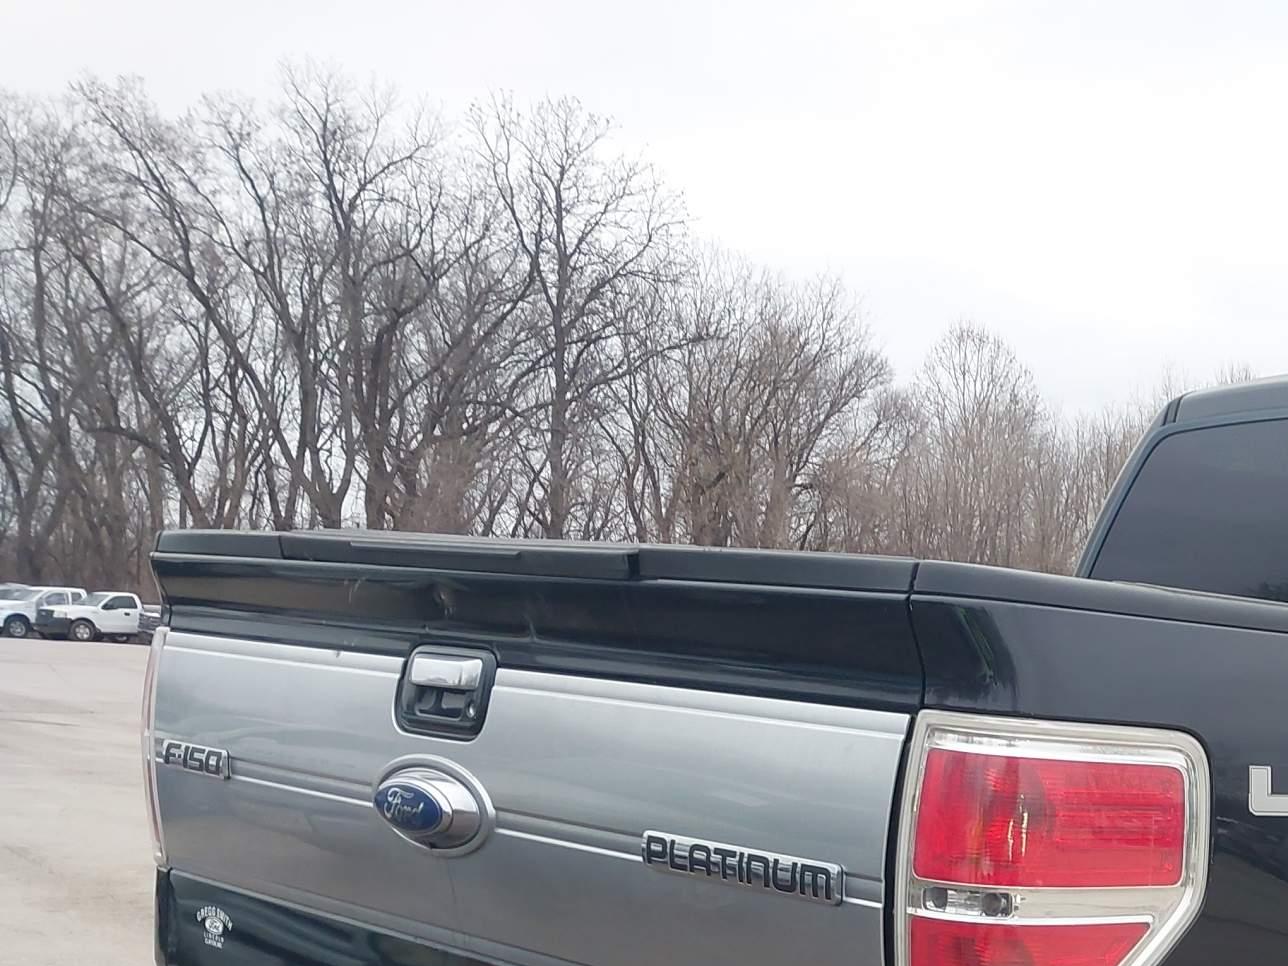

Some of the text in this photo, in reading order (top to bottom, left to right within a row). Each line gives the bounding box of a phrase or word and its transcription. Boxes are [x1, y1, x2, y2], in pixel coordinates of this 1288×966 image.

[164, 742, 223, 776] F-150
[383, 787, 425, 819] Ford
[646, 835, 832, 900] PLATINUM
